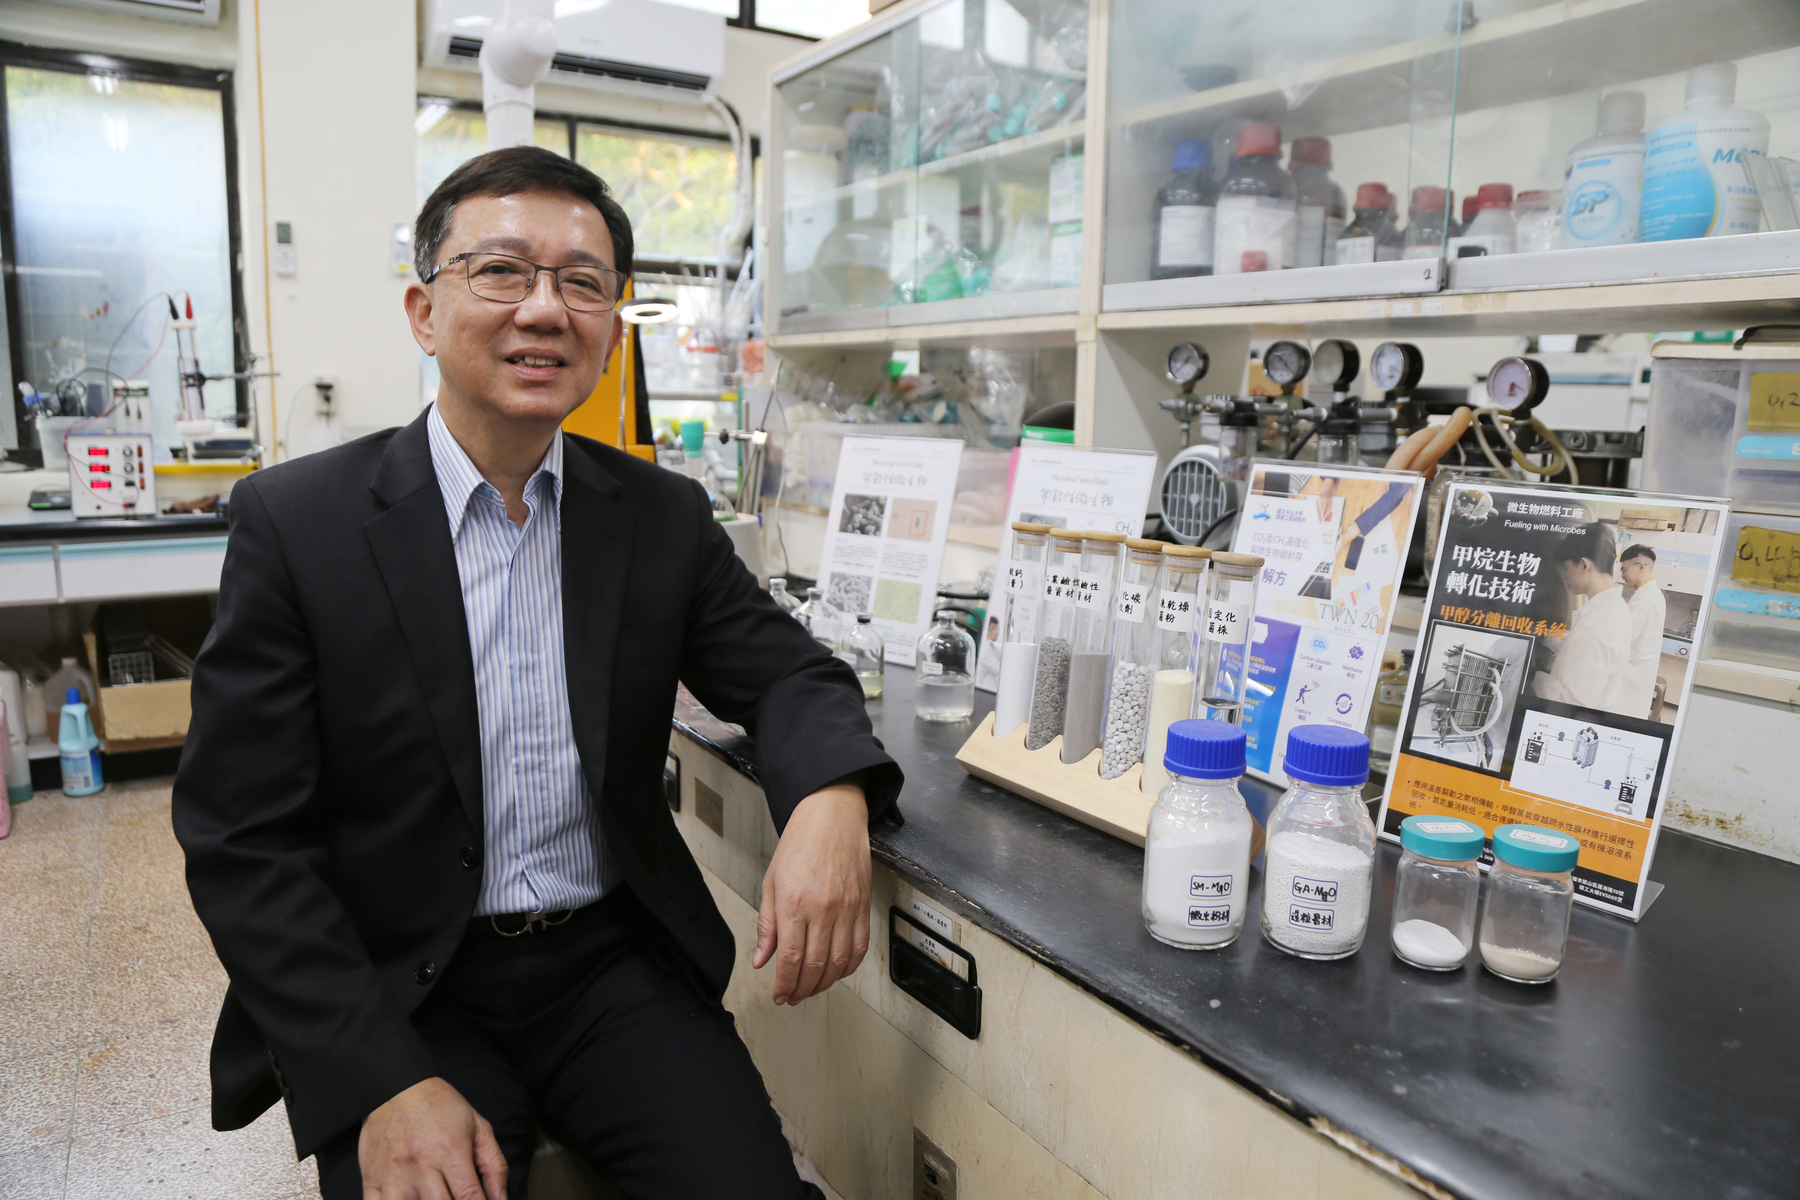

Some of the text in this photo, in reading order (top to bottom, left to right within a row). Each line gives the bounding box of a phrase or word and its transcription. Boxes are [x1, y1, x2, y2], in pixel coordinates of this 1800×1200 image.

[1040, 487, 1115, 507] 功能性微生物
[1506, 501, 1585, 519] 微生物燃料工廠
[1504, 519, 1587, 535] Fueling with Microbes
[1452, 544, 1542, 577] 甲烷生物
[1445, 570, 1536, 605] 轉化技術
[1319, 603, 1359, 625] TWN
[1440, 604, 1568, 640] 甲醇分離回收系統
[1300, 653, 1332, 666] Carbon dioxide
[1342, 664, 1363, 674] Methane
[1294, 707, 1312, 716] Capture
[1327, 716, 1353, 728] Conversion
